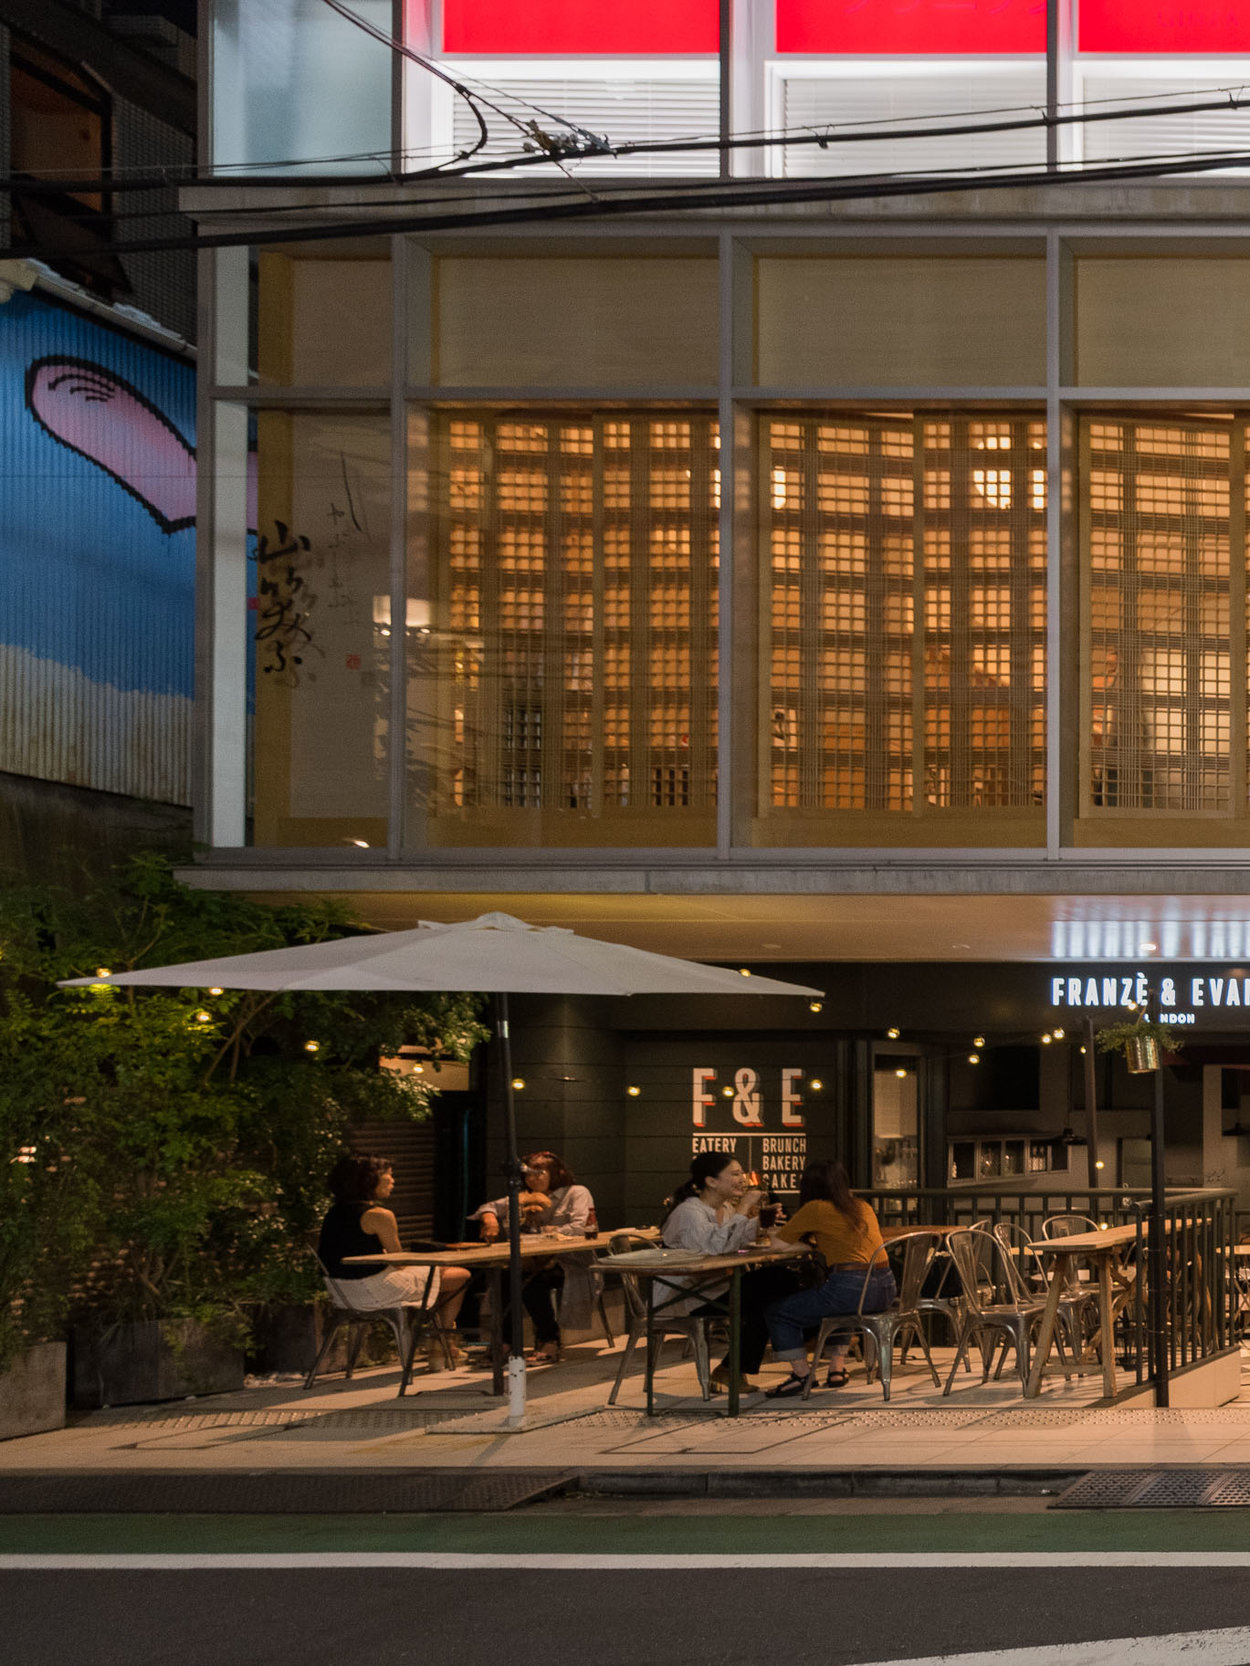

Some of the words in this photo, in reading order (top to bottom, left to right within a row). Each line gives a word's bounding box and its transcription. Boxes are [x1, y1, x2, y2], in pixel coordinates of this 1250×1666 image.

[1052, 972, 1149, 1006] FRANZÈ
[1160, 978, 1176, 1006] &
[1144, 1013, 1195, 1025] LNDON
[692, 1067, 717, 1127] F
[732, 1067, 763, 1127] &
[781, 1067, 805, 1127] E
[692, 1137, 737, 1153] EATERY
[762, 1137, 806, 1153] BRUNCH
[762, 1155, 806, 1171] BAKERY
[762, 1173, 803, 1189] CAKE
